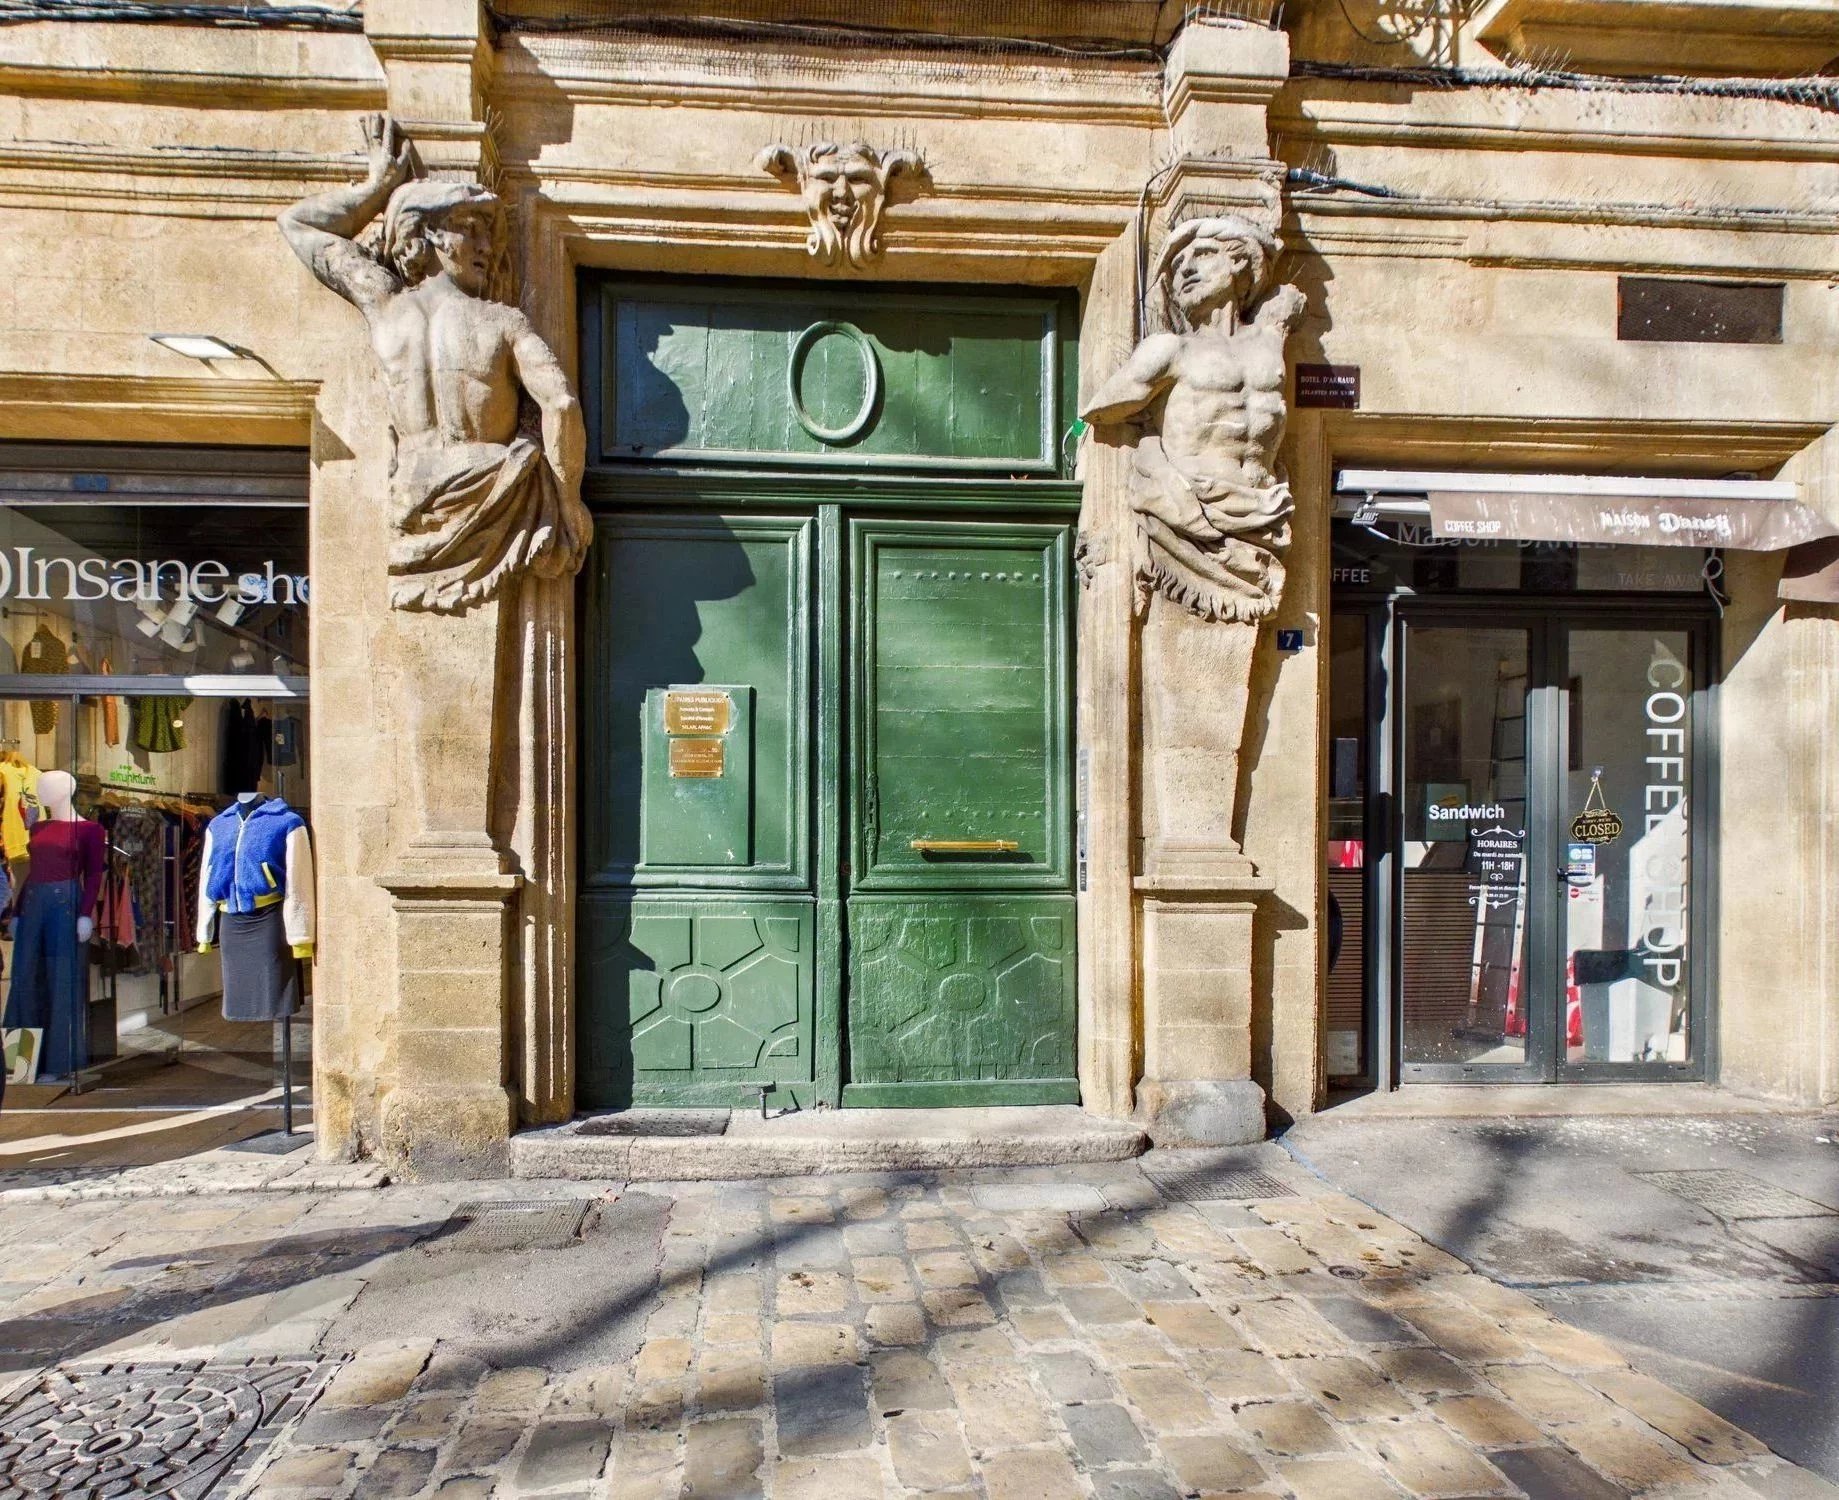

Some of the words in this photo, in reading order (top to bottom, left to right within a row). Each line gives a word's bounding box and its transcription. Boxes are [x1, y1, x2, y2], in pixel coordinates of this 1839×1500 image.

[1444, 520, 1475, 533] COFFEE
[1476, 521, 1502, 534] SHOP
[1600, 511, 1650, 529] MAISON
[1286, 633, 1294, 647] 7
[1429, 804, 1505, 820] Sandwich
[1575, 823, 1620, 837] CLOSED
[1477, 840, 1518, 848] HORAIRES
[1482, 861, 1495, 870] 11H
